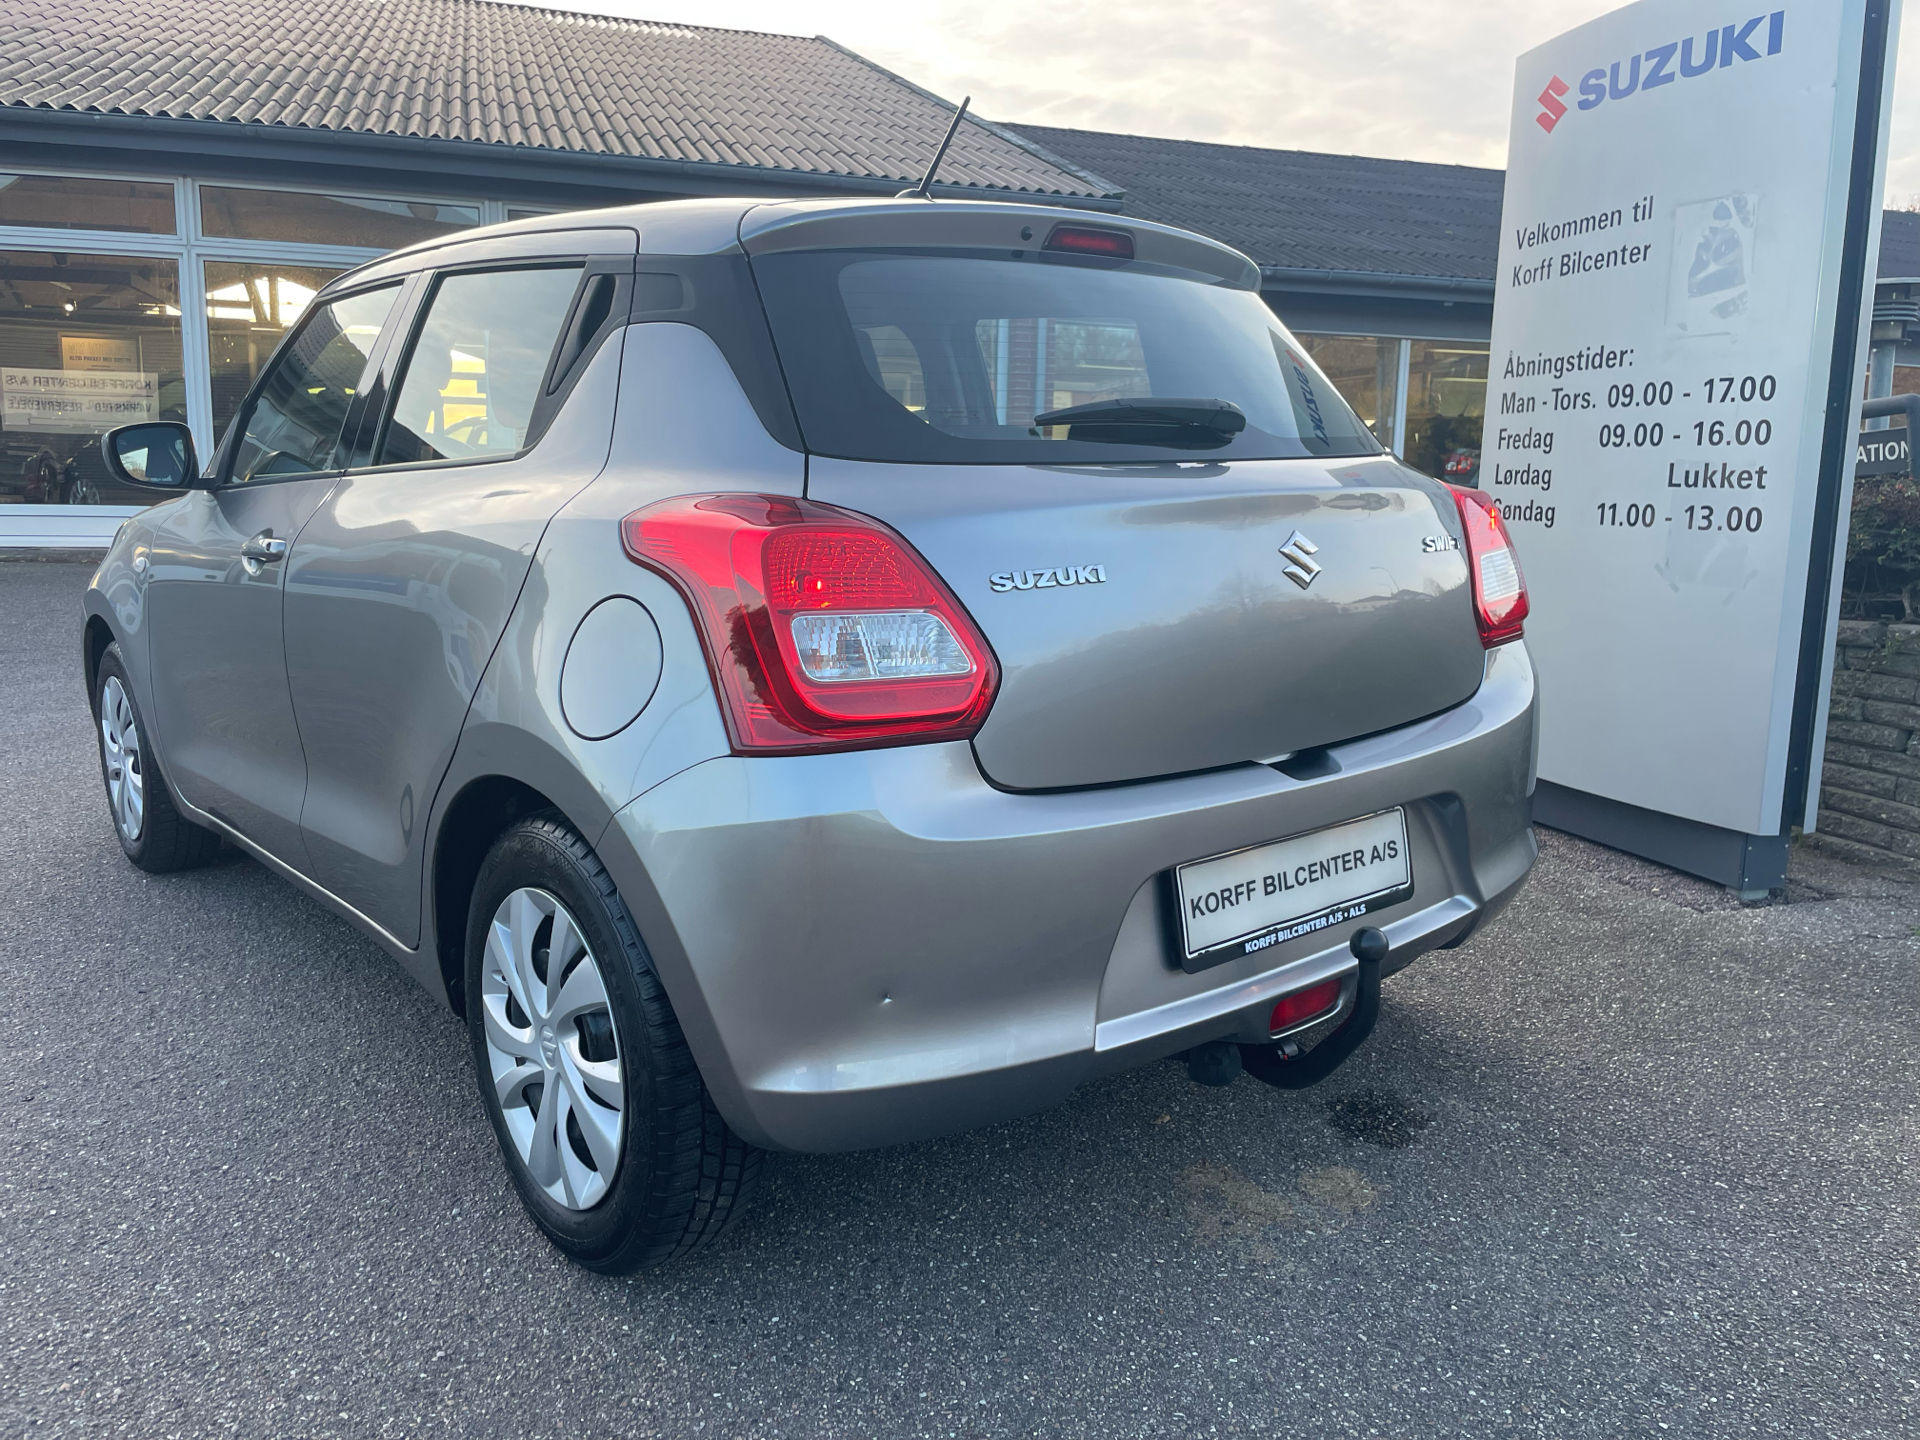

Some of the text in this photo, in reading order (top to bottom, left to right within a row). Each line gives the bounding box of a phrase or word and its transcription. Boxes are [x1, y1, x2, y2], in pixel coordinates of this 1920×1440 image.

[1577, 10, 1785, 111] SUZUKI
[1516, 195, 1654, 250] Velkommen til
[1512, 243, 1652, 288] Korff Bilcenter
[1503, 346, 1635, 379] Åbningstider:
[1501, 391, 1536, 415] Man
[1551, 388, 1596, 412] Tors.
[1607, 381, 1673, 408] 09.00
[1704, 374, 1777, 404] 17.00
[1497, 428, 1554, 454] Fredag
[1599, 422, 1664, 448] 09.00
[1693, 419, 1772, 447] 16.00
[1494, 463, 1768, 491] Lørdag Lukket
[1597, 502, 1656, 528] 11.00
[1684, 504, 1763, 533] 13.00
[989, 564, 1106, 593] SUZUKI
[1190, 840, 1398, 919] KORFF BILCENTER A/S
[1245, 904, 1367, 954] KORFF BILCENTER A/S ALS
